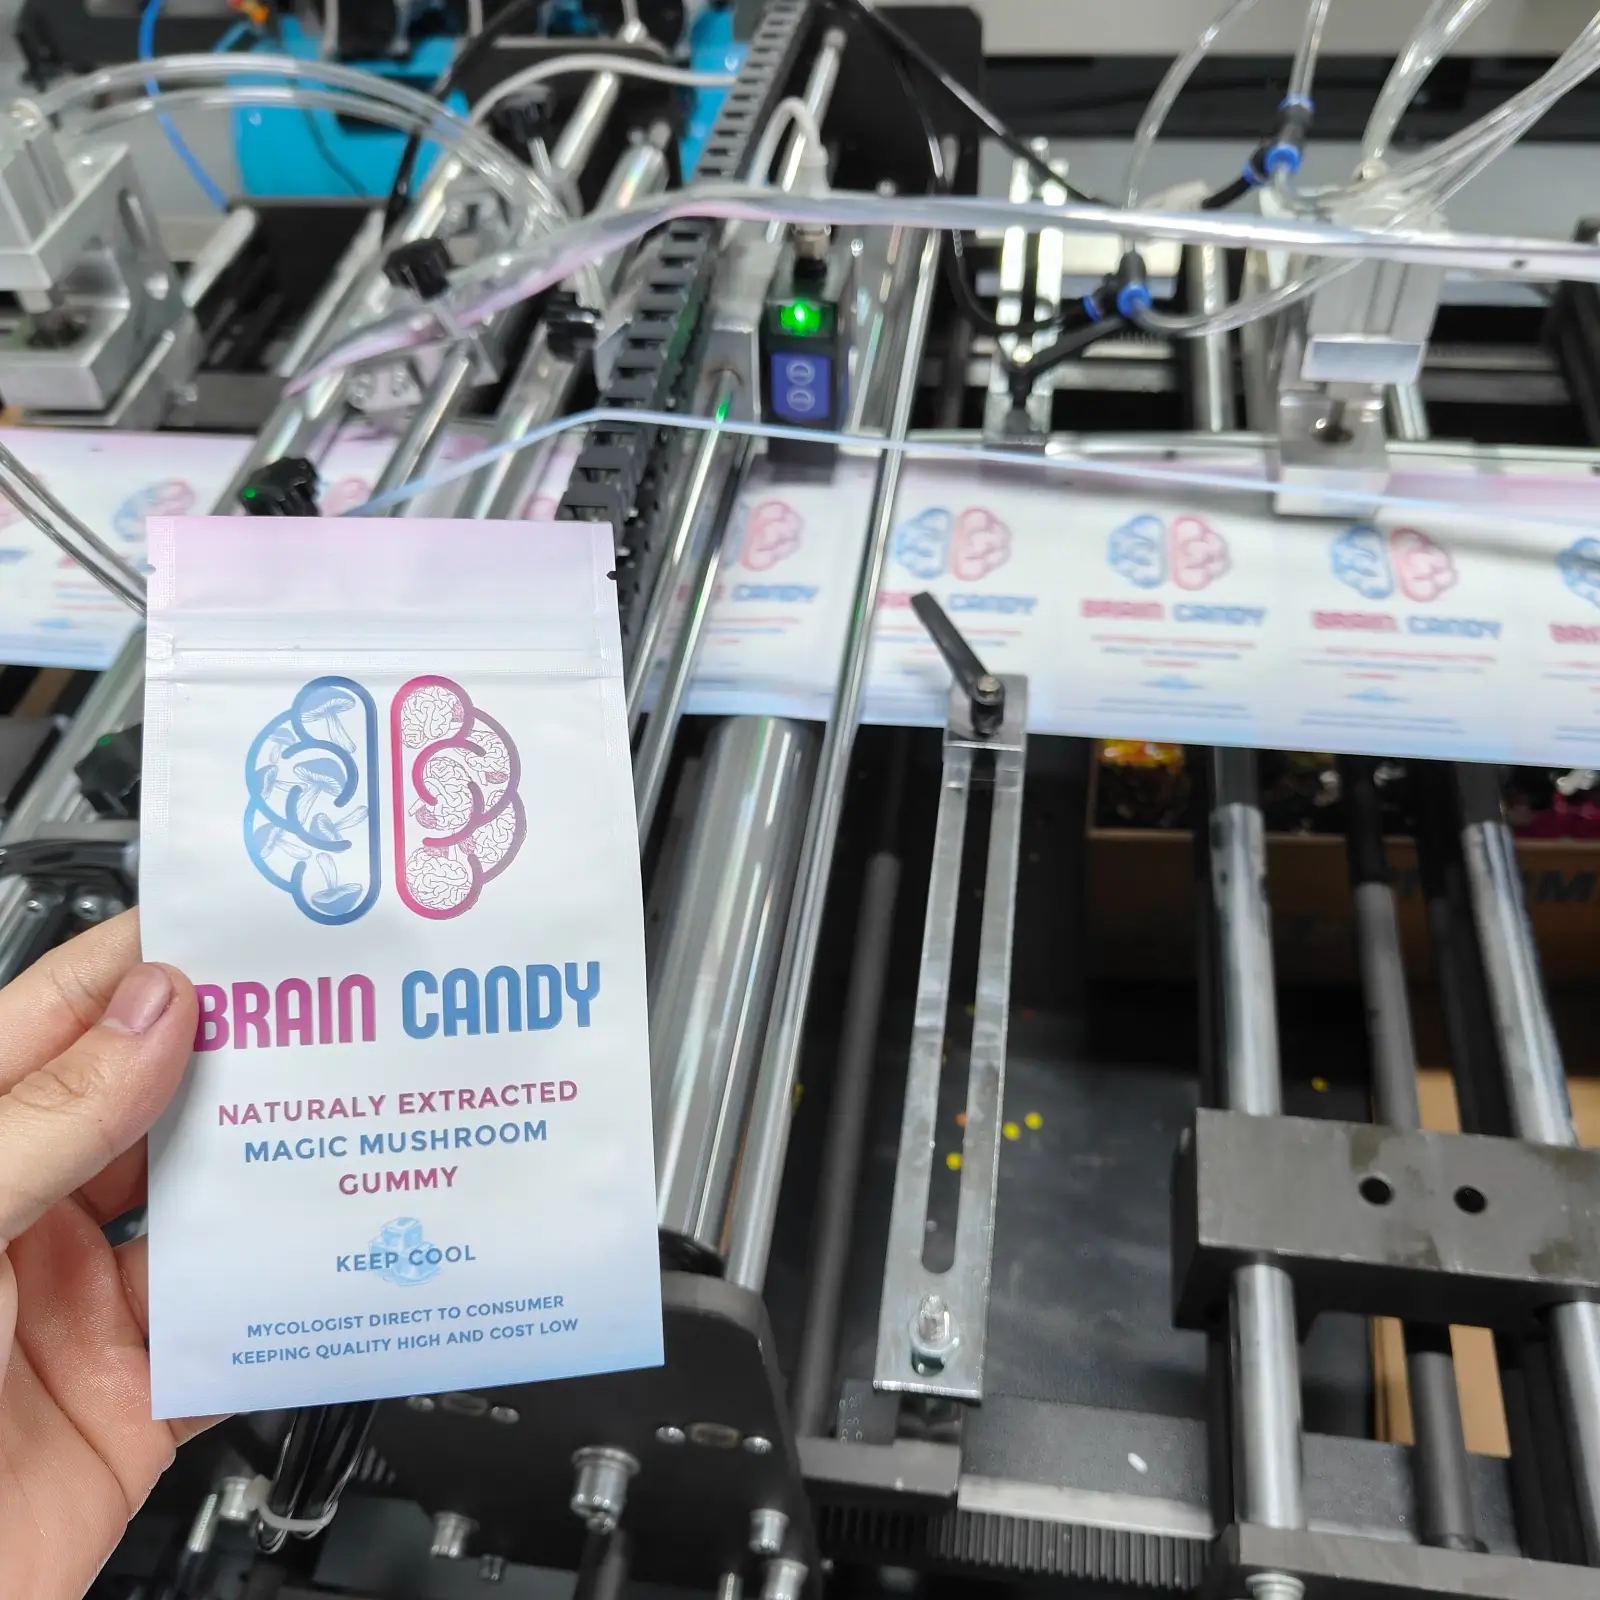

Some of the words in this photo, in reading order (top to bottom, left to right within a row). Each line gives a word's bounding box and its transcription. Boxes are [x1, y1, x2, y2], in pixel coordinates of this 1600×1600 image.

[193, 973, 377, 1053] BRAIN
[401, 960, 601, 1040] CANDY
[218, 1094, 387, 1126] NATURALY
[398, 1080, 579, 1115] EXTRACTED
[244, 1135, 348, 1164] MAGIC
[359, 1119, 548, 1156] MUSHROOM
[338, 1165, 459, 1196] GUMMY
[336, 1250, 400, 1273] KEEP
[407, 1244, 477, 1267] COOL
[247, 1314, 364, 1338] MYCOLOGIST
[369, 1308, 433, 1327] DIRECT
[437, 1306, 462, 1321] TO
[465, 1295, 565, 1318] CONSUMER
[232, 1346, 311, 1365] KEEPING
[315, 1338, 392, 1360] QUALITY
[397, 1333, 441, 1350] HIGH
[446, 1329, 484, 1345] AND
[489, 1323, 535, 1340] COST
[540, 1318, 579, 1335] LOW
